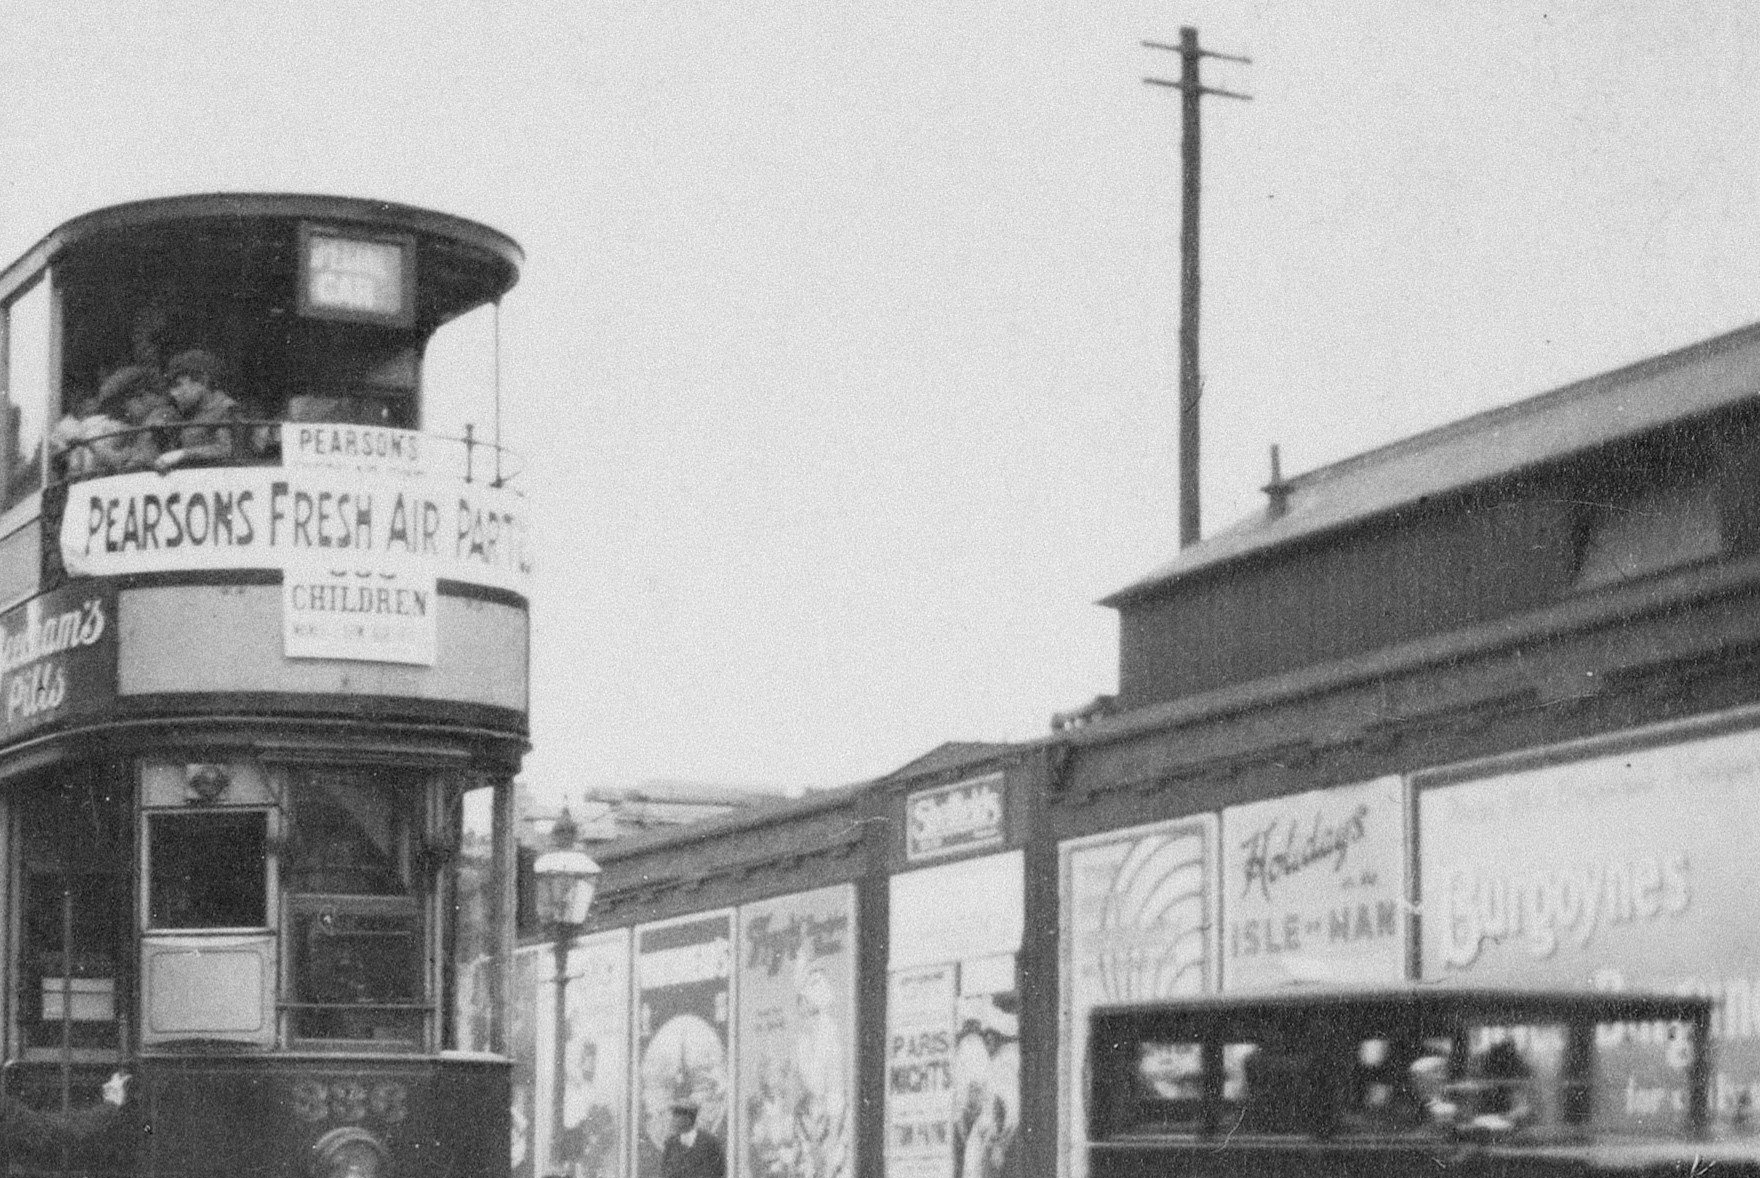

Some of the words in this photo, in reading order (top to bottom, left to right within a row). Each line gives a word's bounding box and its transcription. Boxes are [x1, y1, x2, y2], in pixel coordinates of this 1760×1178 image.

[85, 491, 255, 556] PEARSONS
[270, 482, 373, 550] FRESH
[387, 491, 441, 556] AIR
[291, 585, 428, 617] CHILDREN
[8, 661, 66, 722] Pills
[1230, 914, 1302, 960] ISLE
[1328, 901, 1398, 943] MAN
